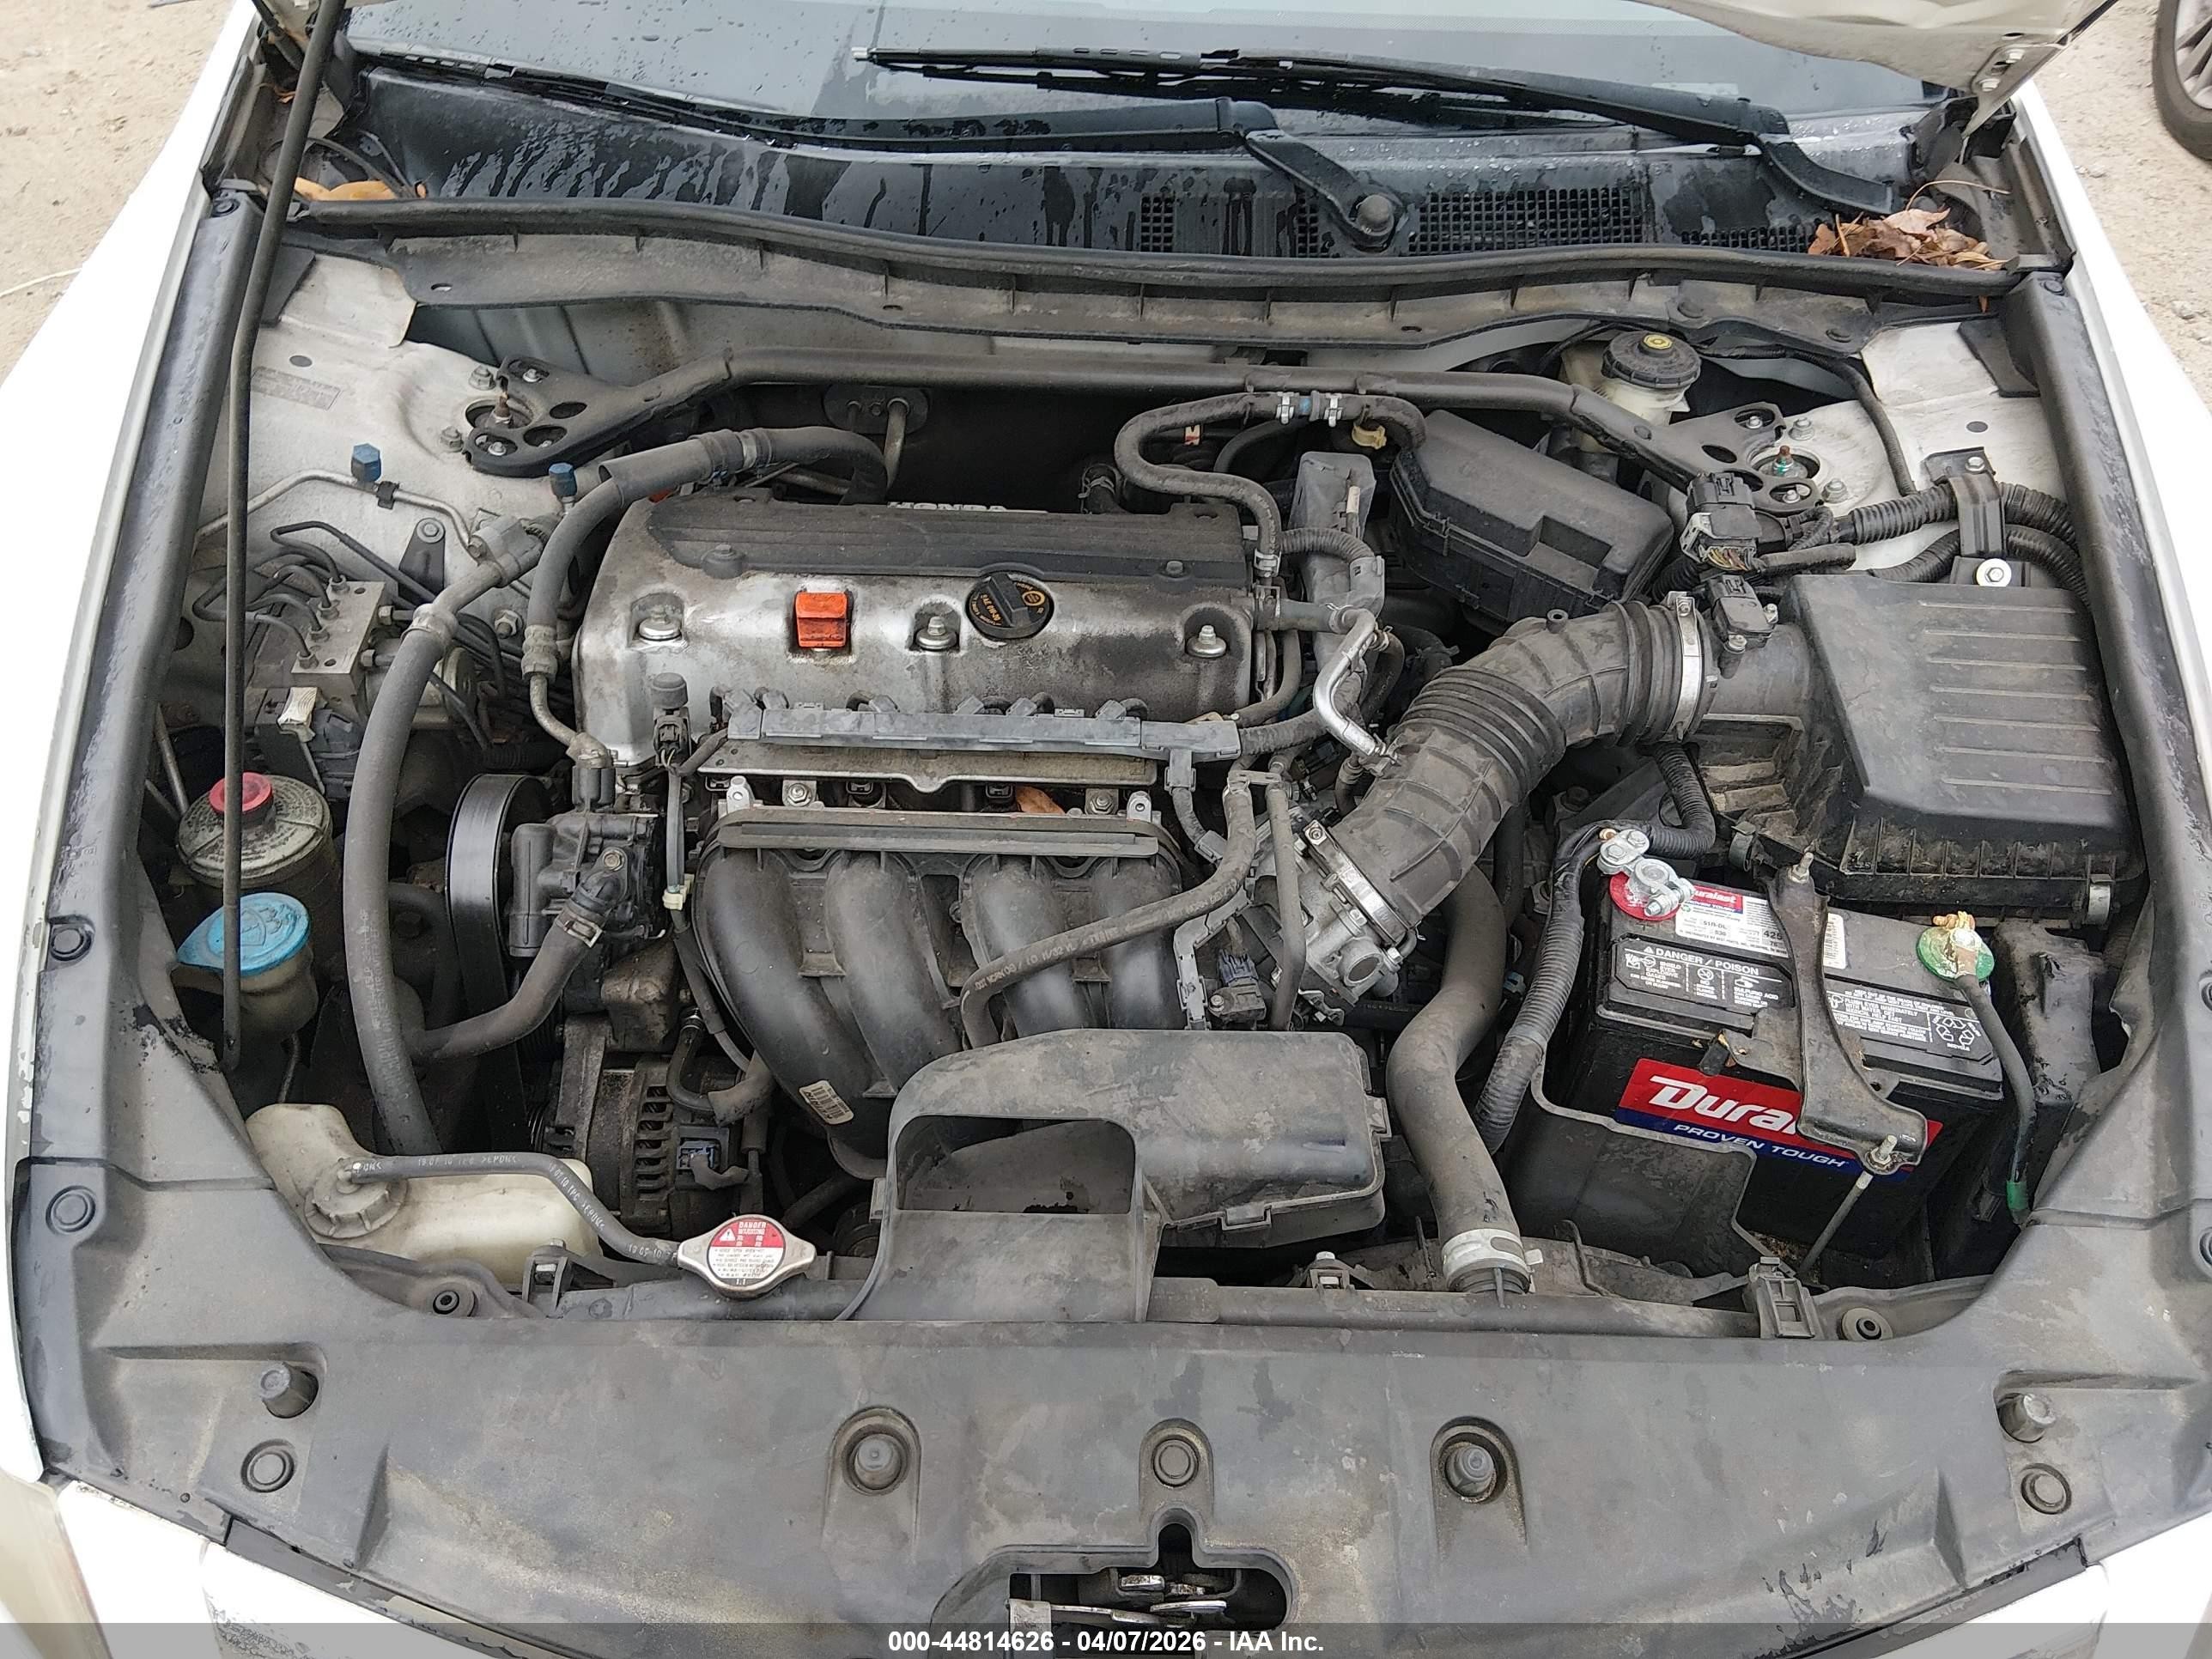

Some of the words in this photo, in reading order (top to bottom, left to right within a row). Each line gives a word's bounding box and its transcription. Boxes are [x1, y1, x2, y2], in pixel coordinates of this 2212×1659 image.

[1693, 888, 1735, 903] uralast
[1763, 929, 1783, 940] 425
[1656, 948, 1703, 964] DANGER
[1715, 959, 1759, 975] POISON
[1844, 1001, 1860, 1010] WITH
[1863, 1000, 1879, 1009] EYES
[1880, 1004, 1917, 1017] IMMEDIATELY
[1674, 1124, 1765, 1149] PROVEN
[1771, 1146, 1845, 1168] TOUGH
